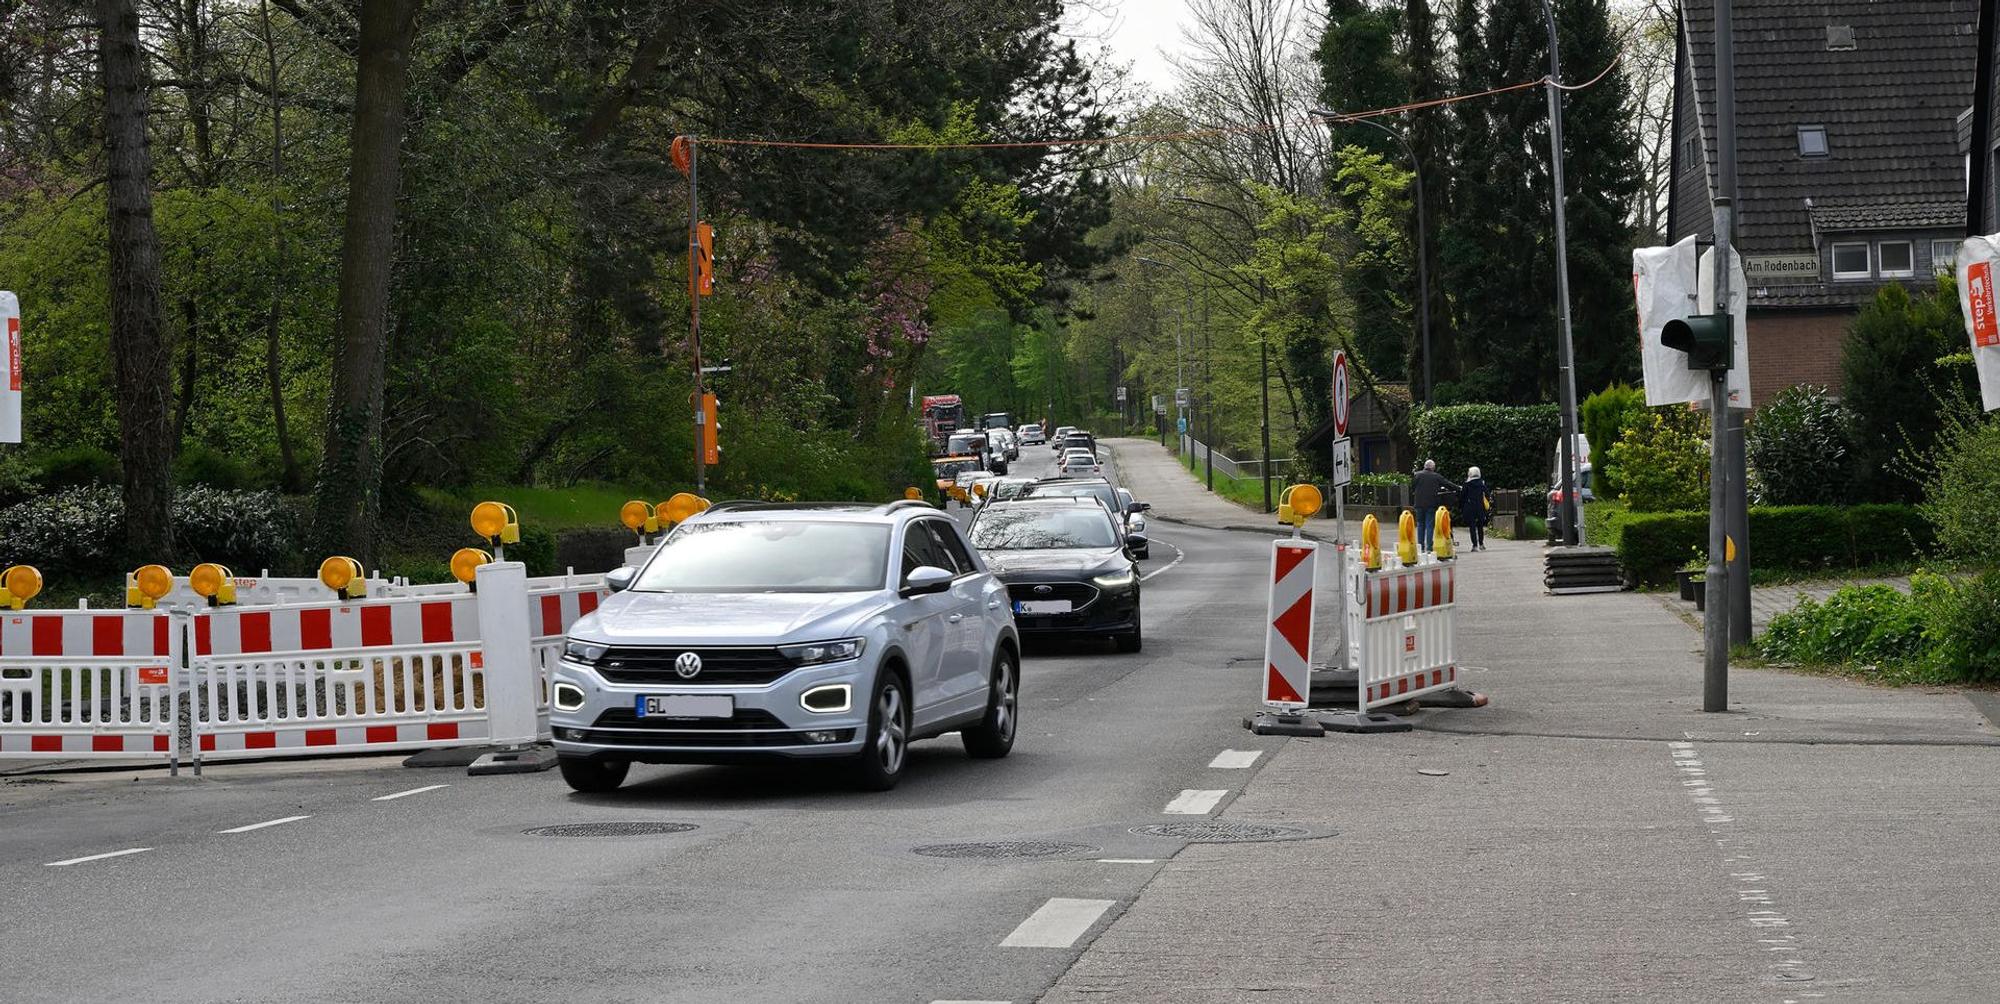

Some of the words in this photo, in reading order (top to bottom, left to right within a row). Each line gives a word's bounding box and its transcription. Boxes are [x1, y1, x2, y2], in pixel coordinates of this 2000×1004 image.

[1746, 260, 1762, 272] Am
[1764, 259, 1817, 272] Rodenbach
[1974, 299, 1986, 331] step
[233, 578, 257, 589] step
[1020, 603, 1027, 612] K
[675, 652, 702, 678] VW
[646, 698, 666, 714] GL
